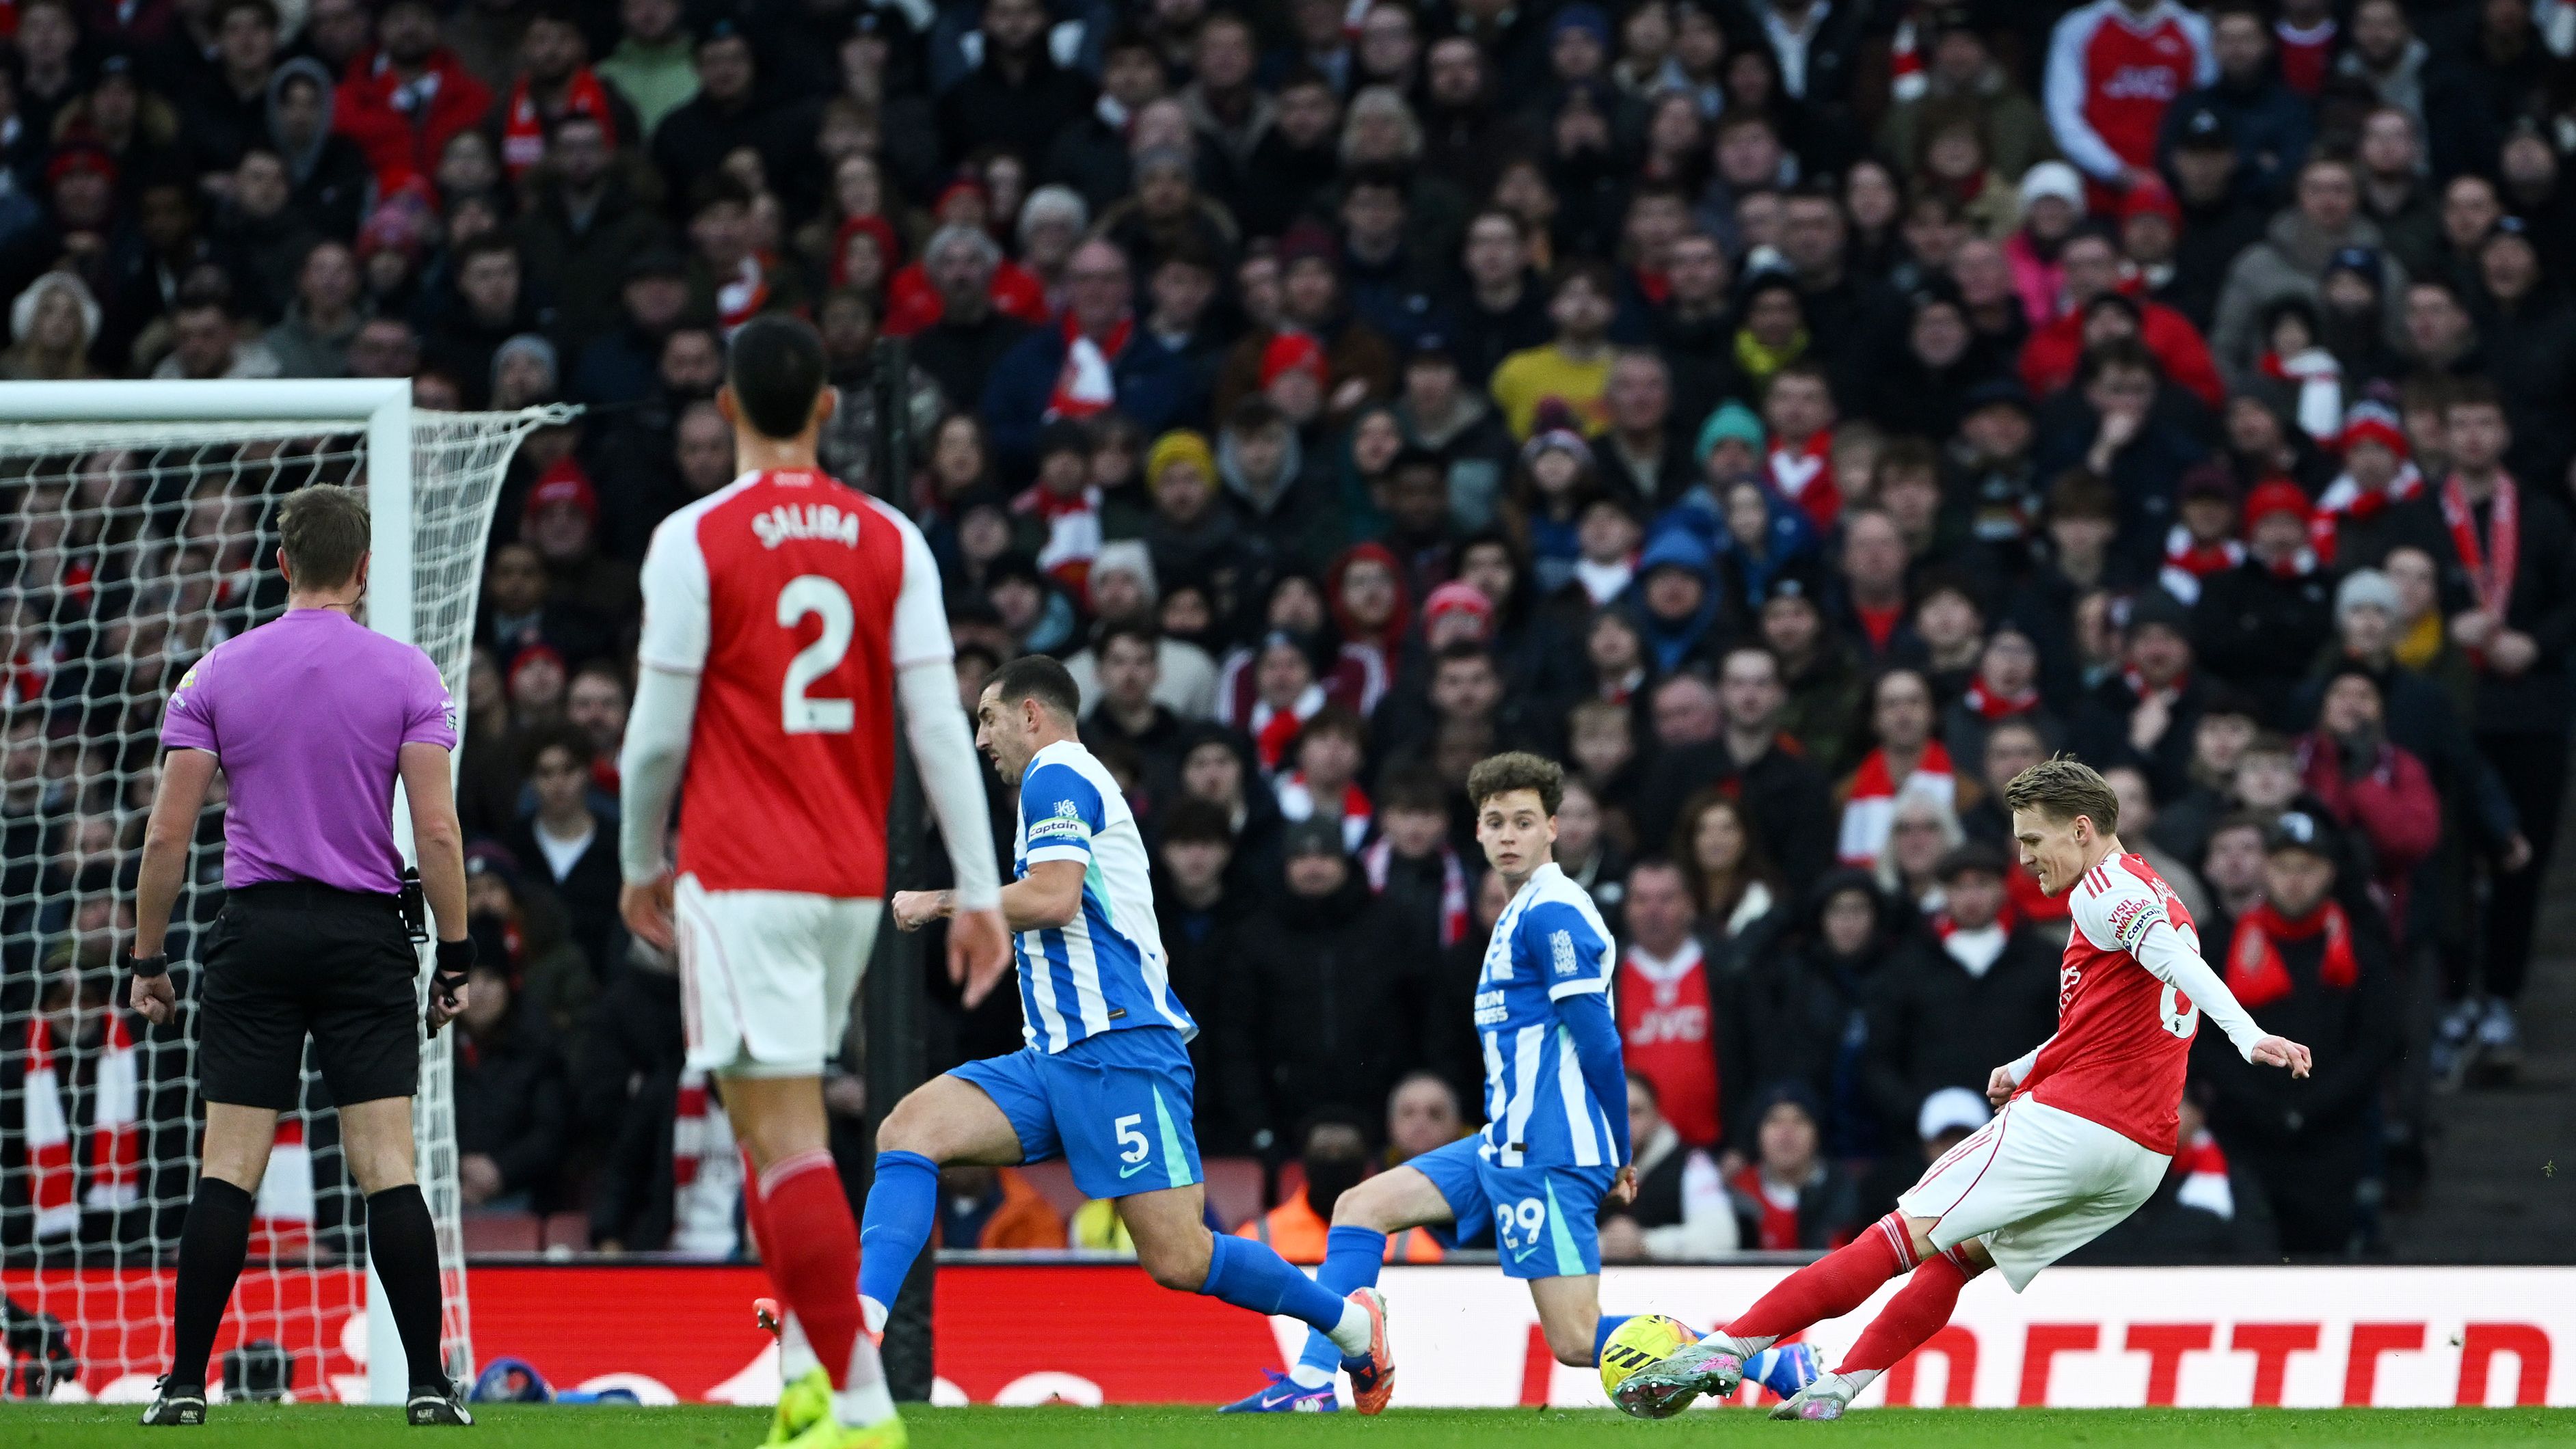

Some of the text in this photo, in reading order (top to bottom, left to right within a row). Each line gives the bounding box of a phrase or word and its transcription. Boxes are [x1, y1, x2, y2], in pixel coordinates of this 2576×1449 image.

[751, 502, 859, 550] SALIBA
[777, 573, 855, 735] 2
[1030, 820, 1078, 837] Captain
[2108, 898, 2132, 923] VISIT
[2115, 899, 2151, 941] RWANDA
[2127, 908, 2164, 940] Captain
[1626, 1005, 1708, 1046] JVC
[1115, 1113, 1149, 1163] 5
[1497, 1197, 1545, 1249] 29
